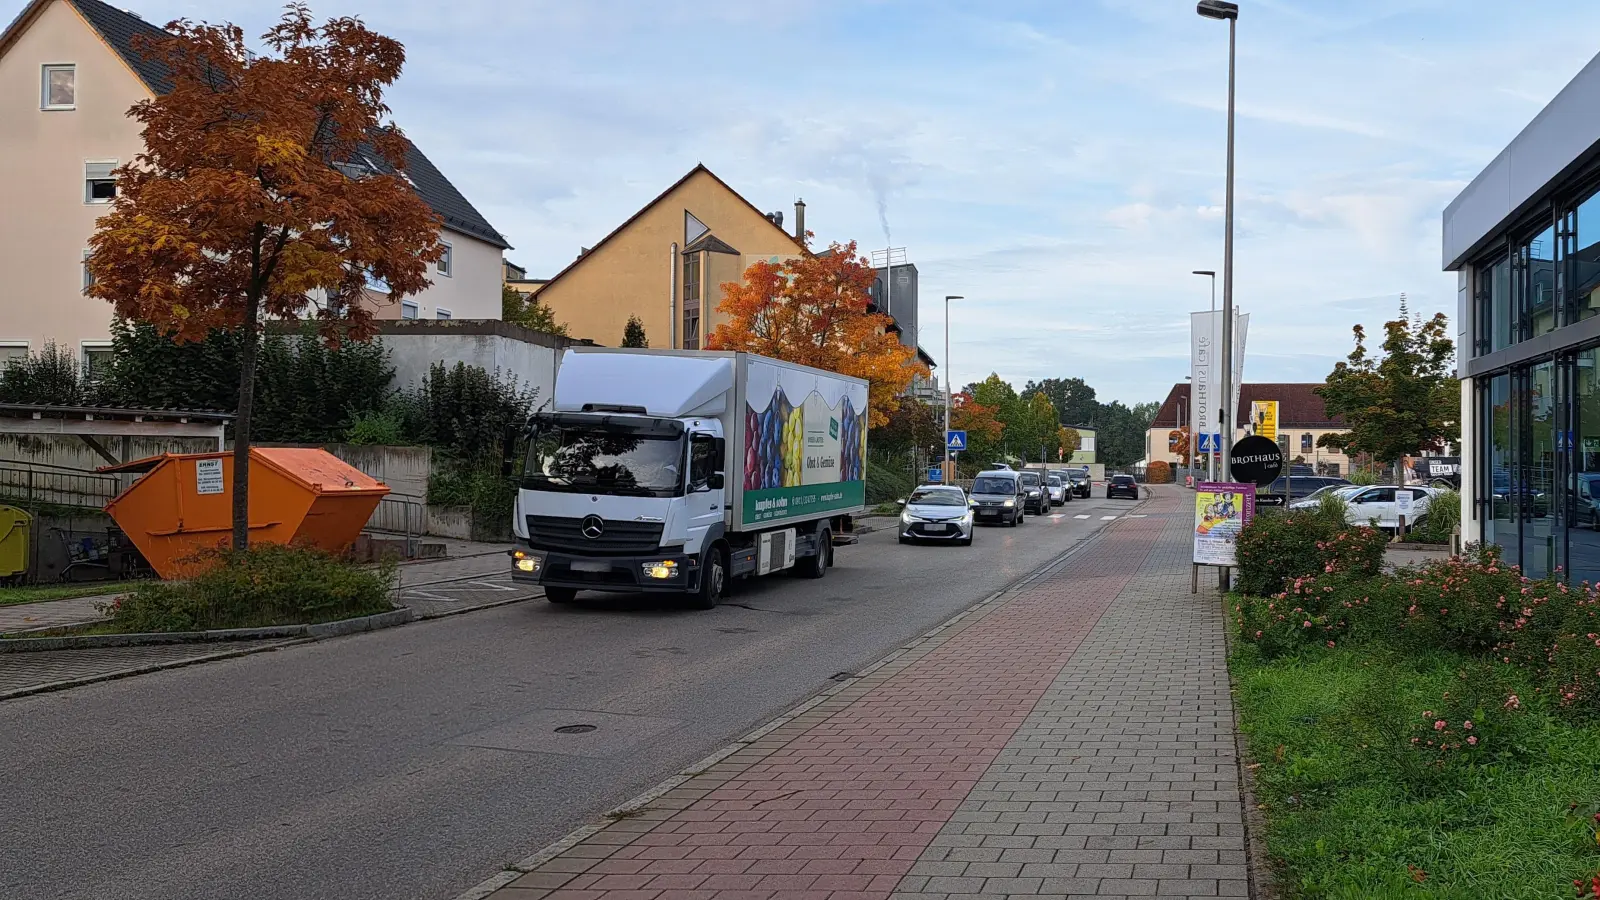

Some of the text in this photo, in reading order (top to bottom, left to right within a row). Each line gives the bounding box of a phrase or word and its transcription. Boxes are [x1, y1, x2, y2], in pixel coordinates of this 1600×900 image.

[807, 456, 815, 468] Obst
[821, 456, 834, 468] Gemüse
[1231, 453, 1280, 465] BROTHAUS
